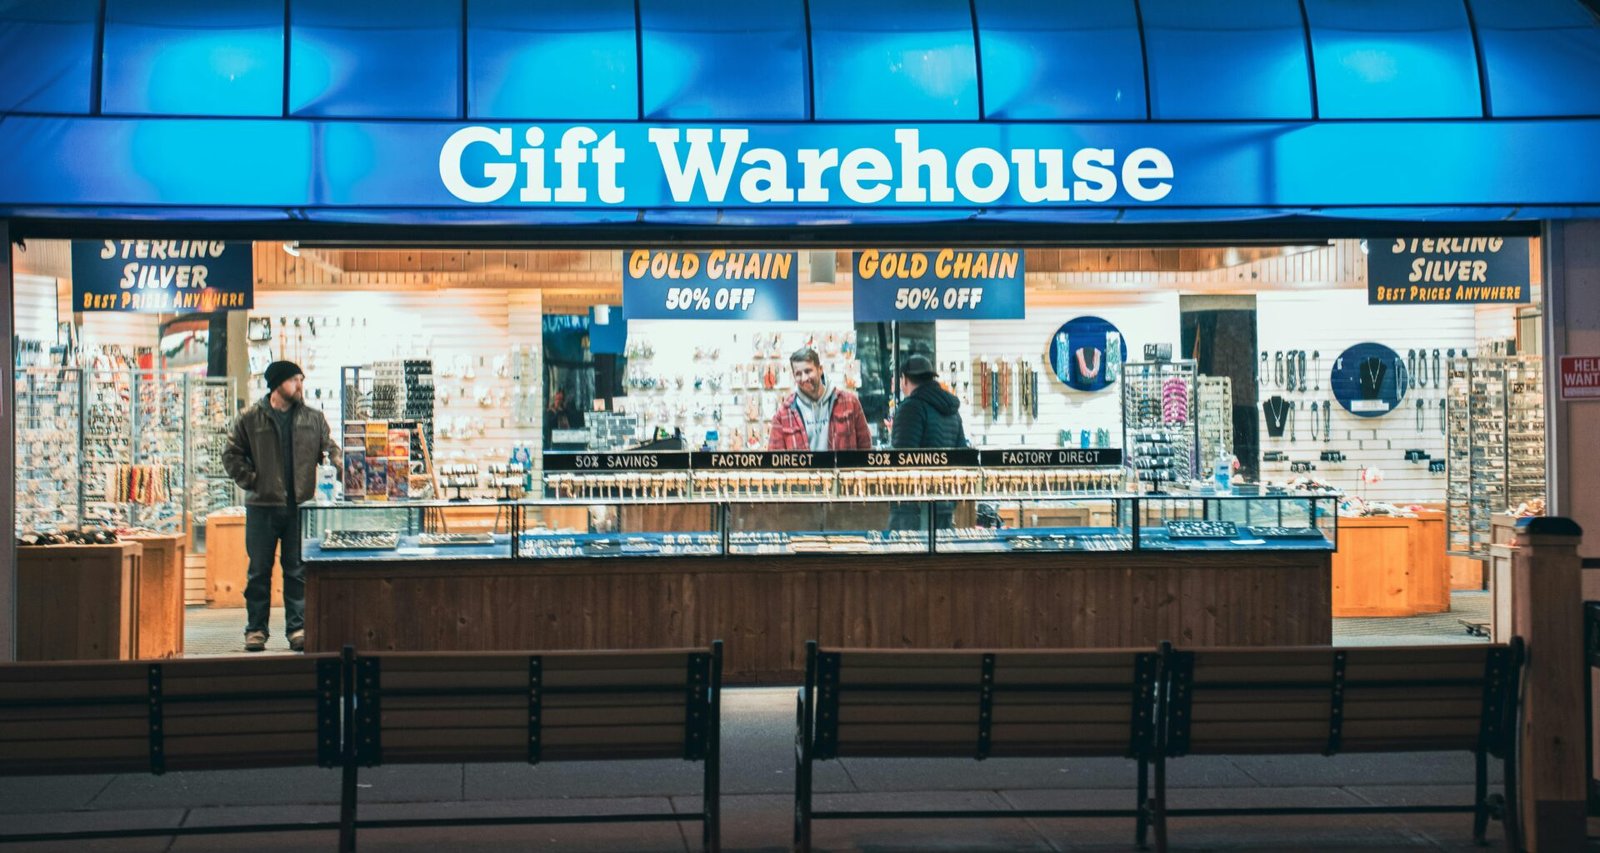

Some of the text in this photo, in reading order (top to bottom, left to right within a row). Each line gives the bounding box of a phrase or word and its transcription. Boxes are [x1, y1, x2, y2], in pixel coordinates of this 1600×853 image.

[439, 126, 1174, 204] Gift Warehouse
[100, 240, 225, 259] STERLING
[1392, 238, 1503, 254] STERLING
[628, 249, 793, 280] GOLD CHAIN
[857, 249, 1019, 279] GOLD CHAIN
[1409, 258, 1487, 282] SILVER
[120, 262, 208, 288] SILVER
[83, 290, 245, 309] BEST PRI ANYWHERE
[665, 287, 756, 311] 50% OFF
[894, 286, 983, 311] 50% OFF
[1376, 284, 1521, 301] BEST PRICES ANYWHERE
[575, 455, 659, 468] 50% SAVINGS
[711, 453, 814, 467] FACTORY DIRECT
[867, 452, 948, 466] 50% SAVINGS
[1002, 450, 1100, 465] FACTORY DIRECT
